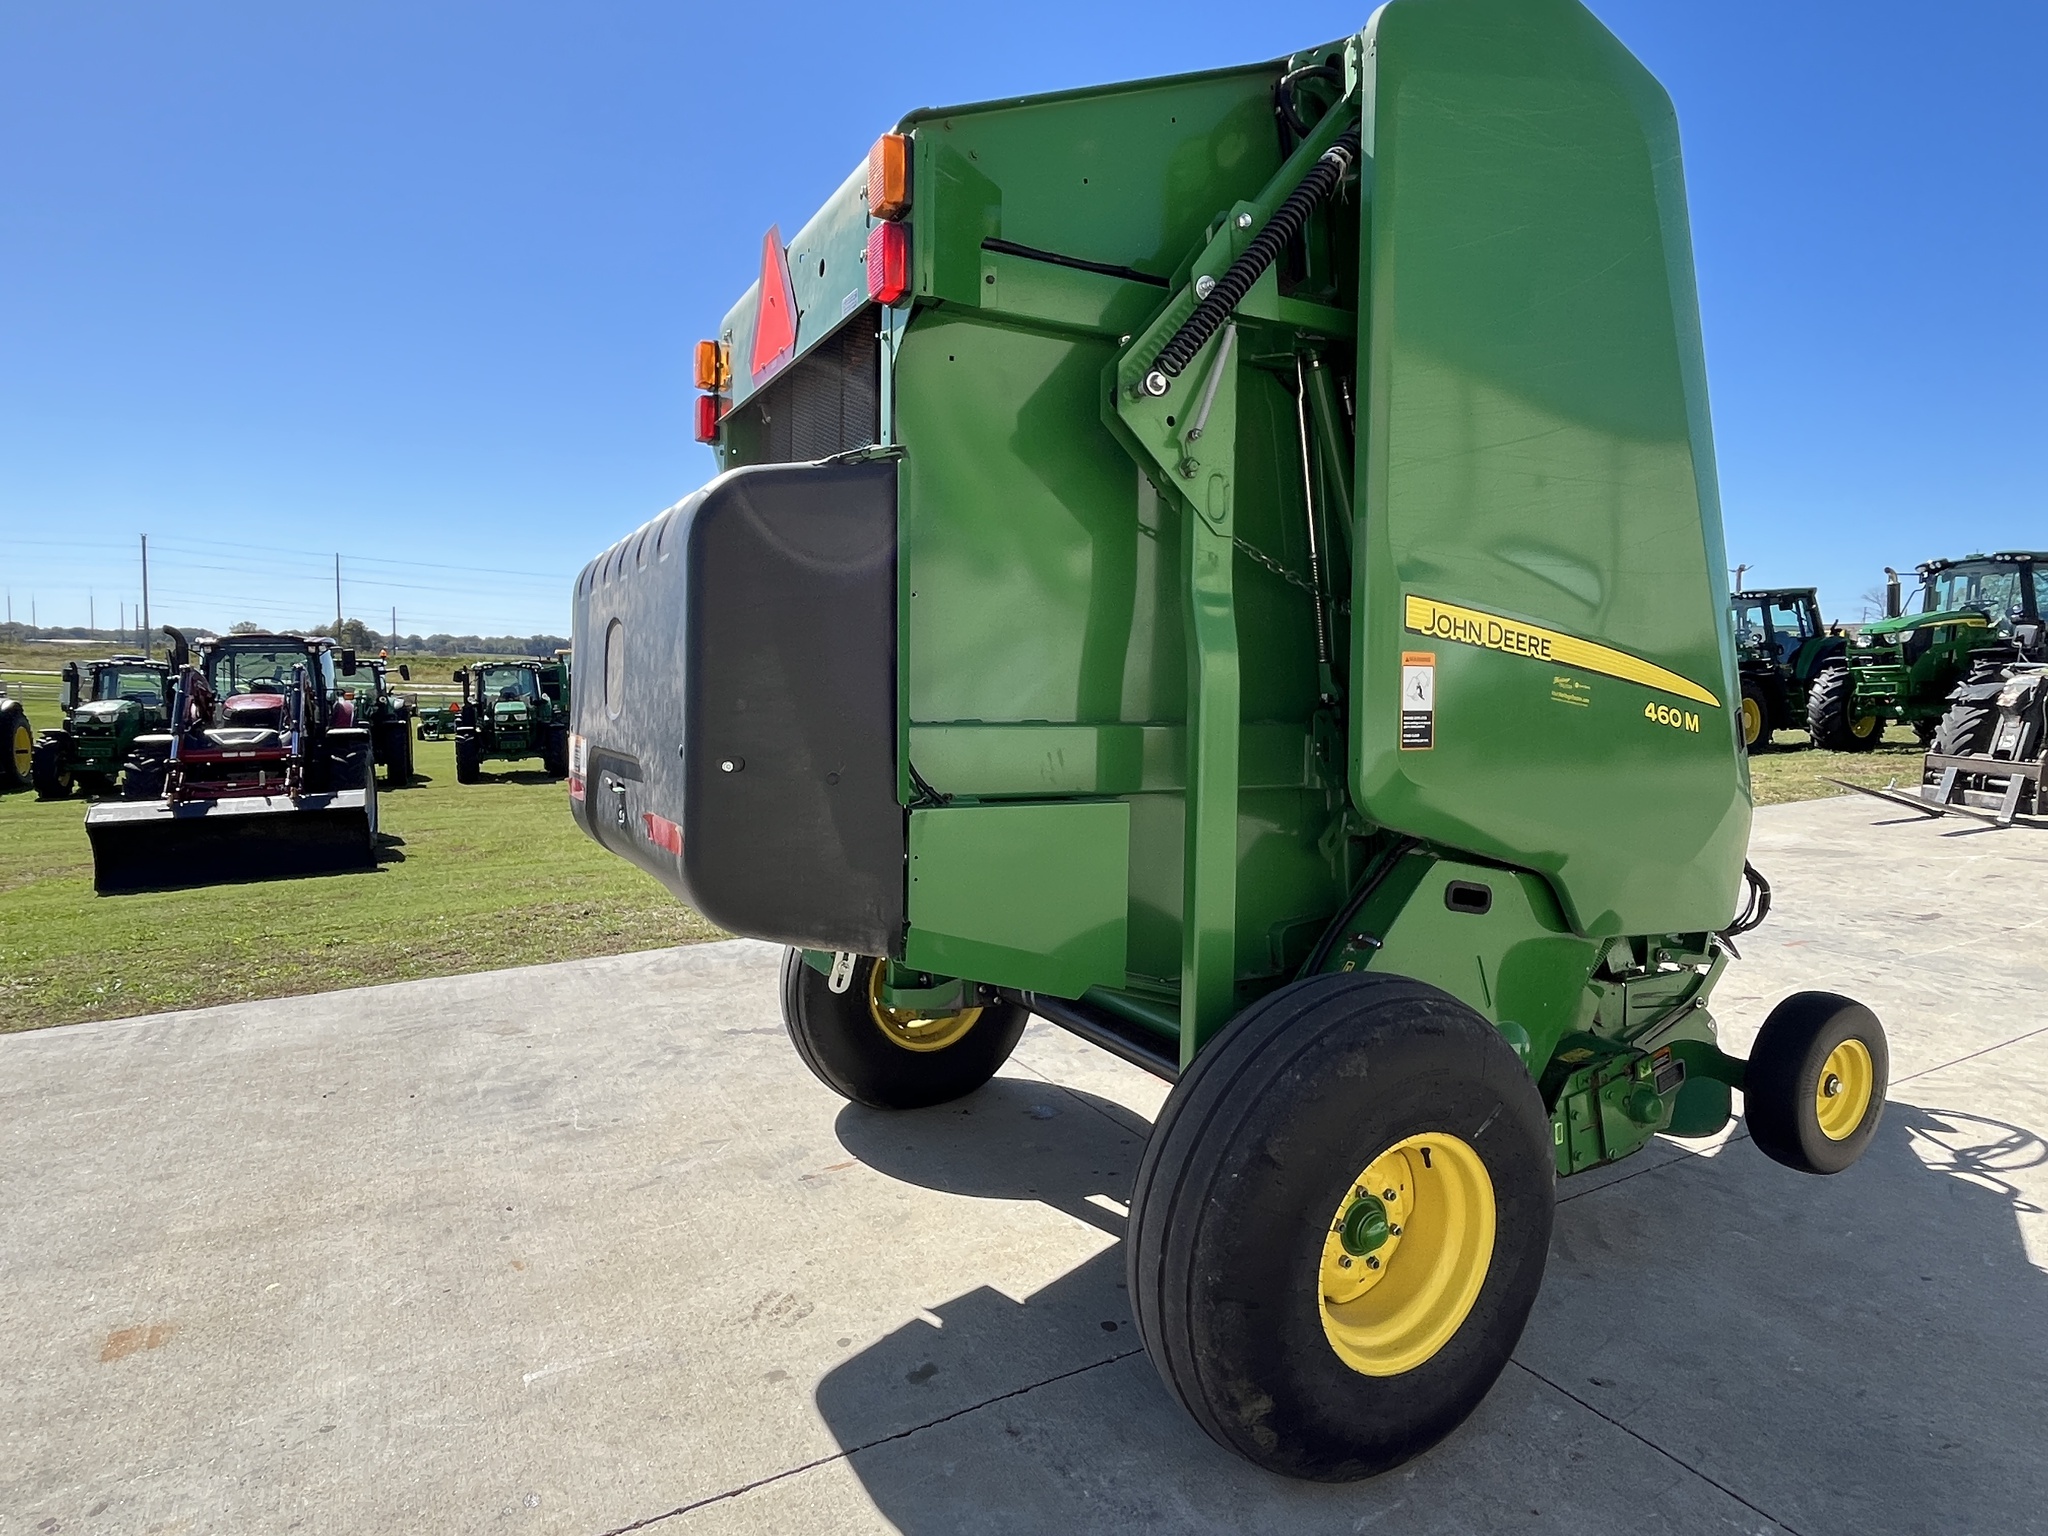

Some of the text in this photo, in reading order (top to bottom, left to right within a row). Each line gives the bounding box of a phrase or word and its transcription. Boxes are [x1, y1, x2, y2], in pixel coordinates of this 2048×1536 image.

[1424, 608, 1552, 658] JOHN DEERE
[1644, 701, 1682, 728] 460
